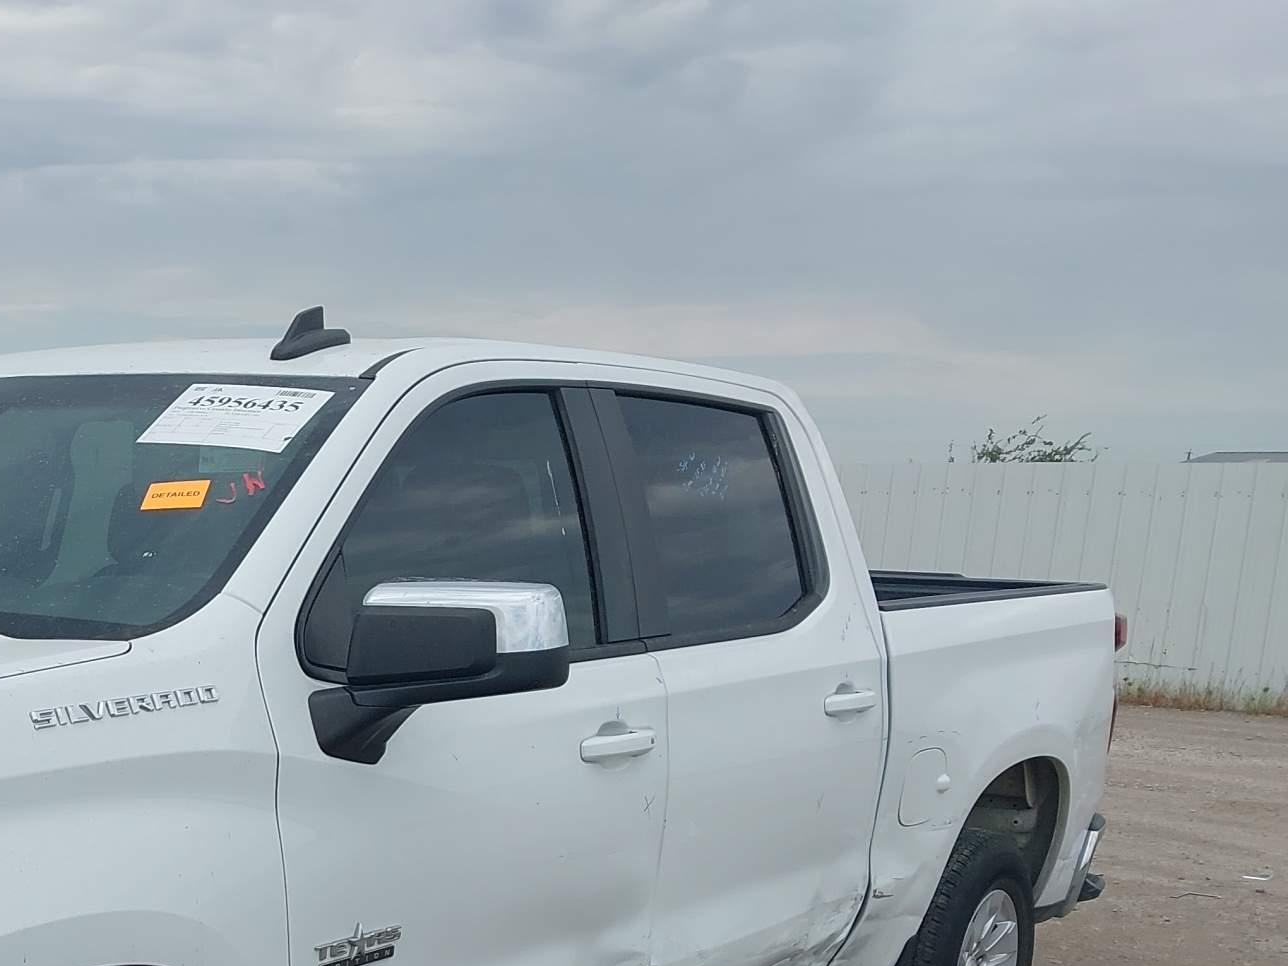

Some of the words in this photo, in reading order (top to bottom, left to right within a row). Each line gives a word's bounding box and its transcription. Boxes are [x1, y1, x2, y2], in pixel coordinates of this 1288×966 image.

[188, 395, 305, 413] 45956435
[151, 490, 201, 499] DETAILED
[29, 684, 220, 730] SILVERADO
